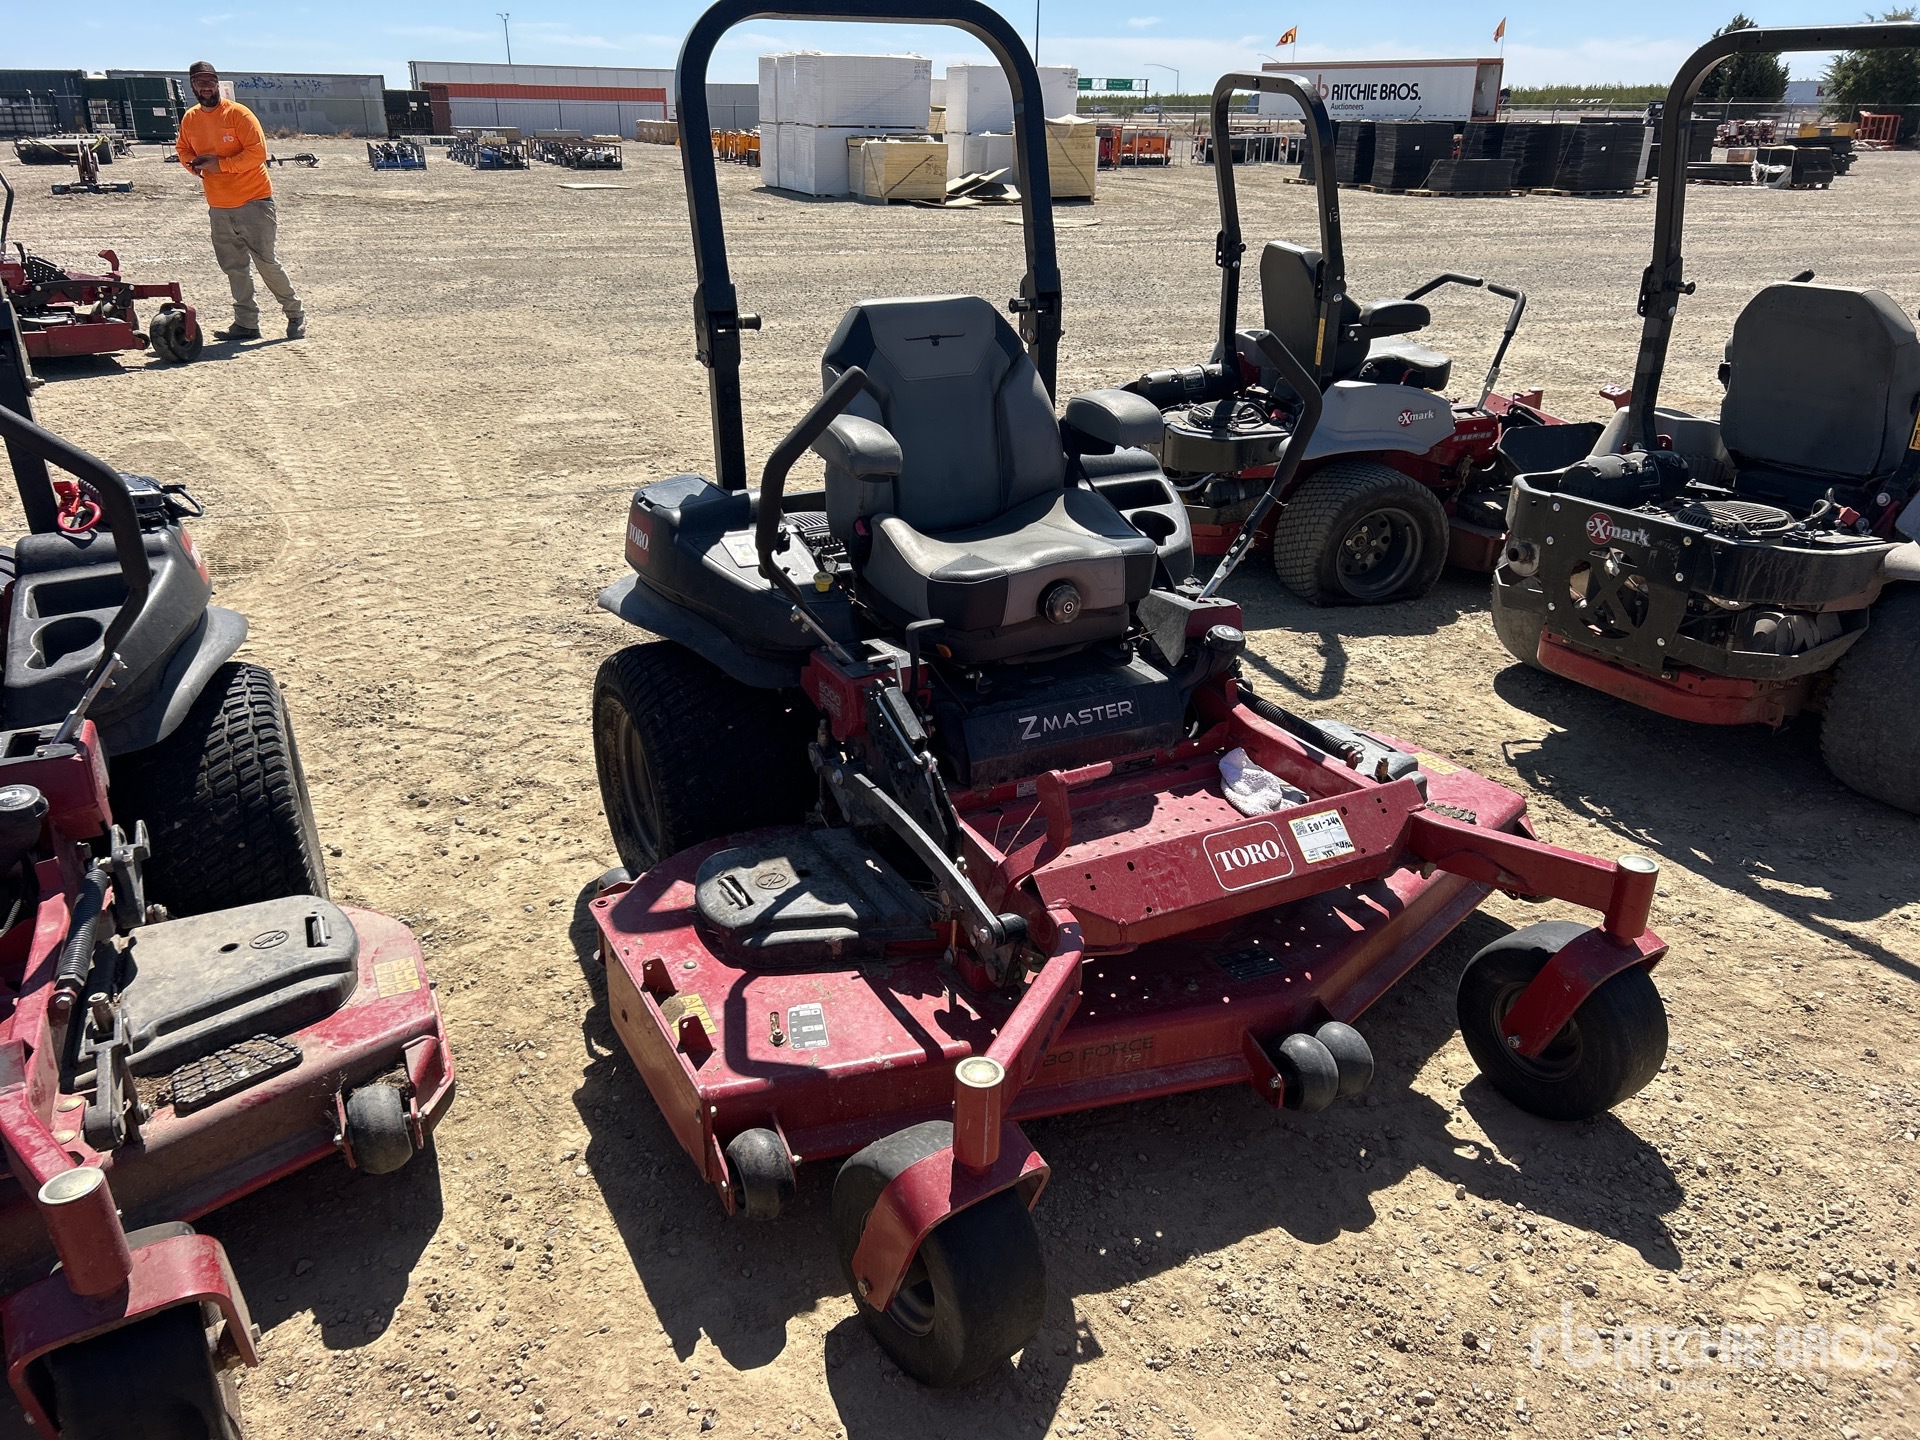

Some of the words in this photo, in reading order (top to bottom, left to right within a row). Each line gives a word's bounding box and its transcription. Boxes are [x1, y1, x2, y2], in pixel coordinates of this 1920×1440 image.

[1331, 83, 1378, 101] RITCHIE
[1379, 82, 1421, 101] BROS.
[1330, 102, 1365, 111] Auctioneers
[629, 522, 649, 550] TORO
[1018, 715, 1042, 741] Z
[1043, 700, 1134, 733] MASTER
[1214, 839, 1280, 872] TORO
[1083, 1036, 1155, 1061] FORCE
[1124, 1053, 1142, 1064] 72
